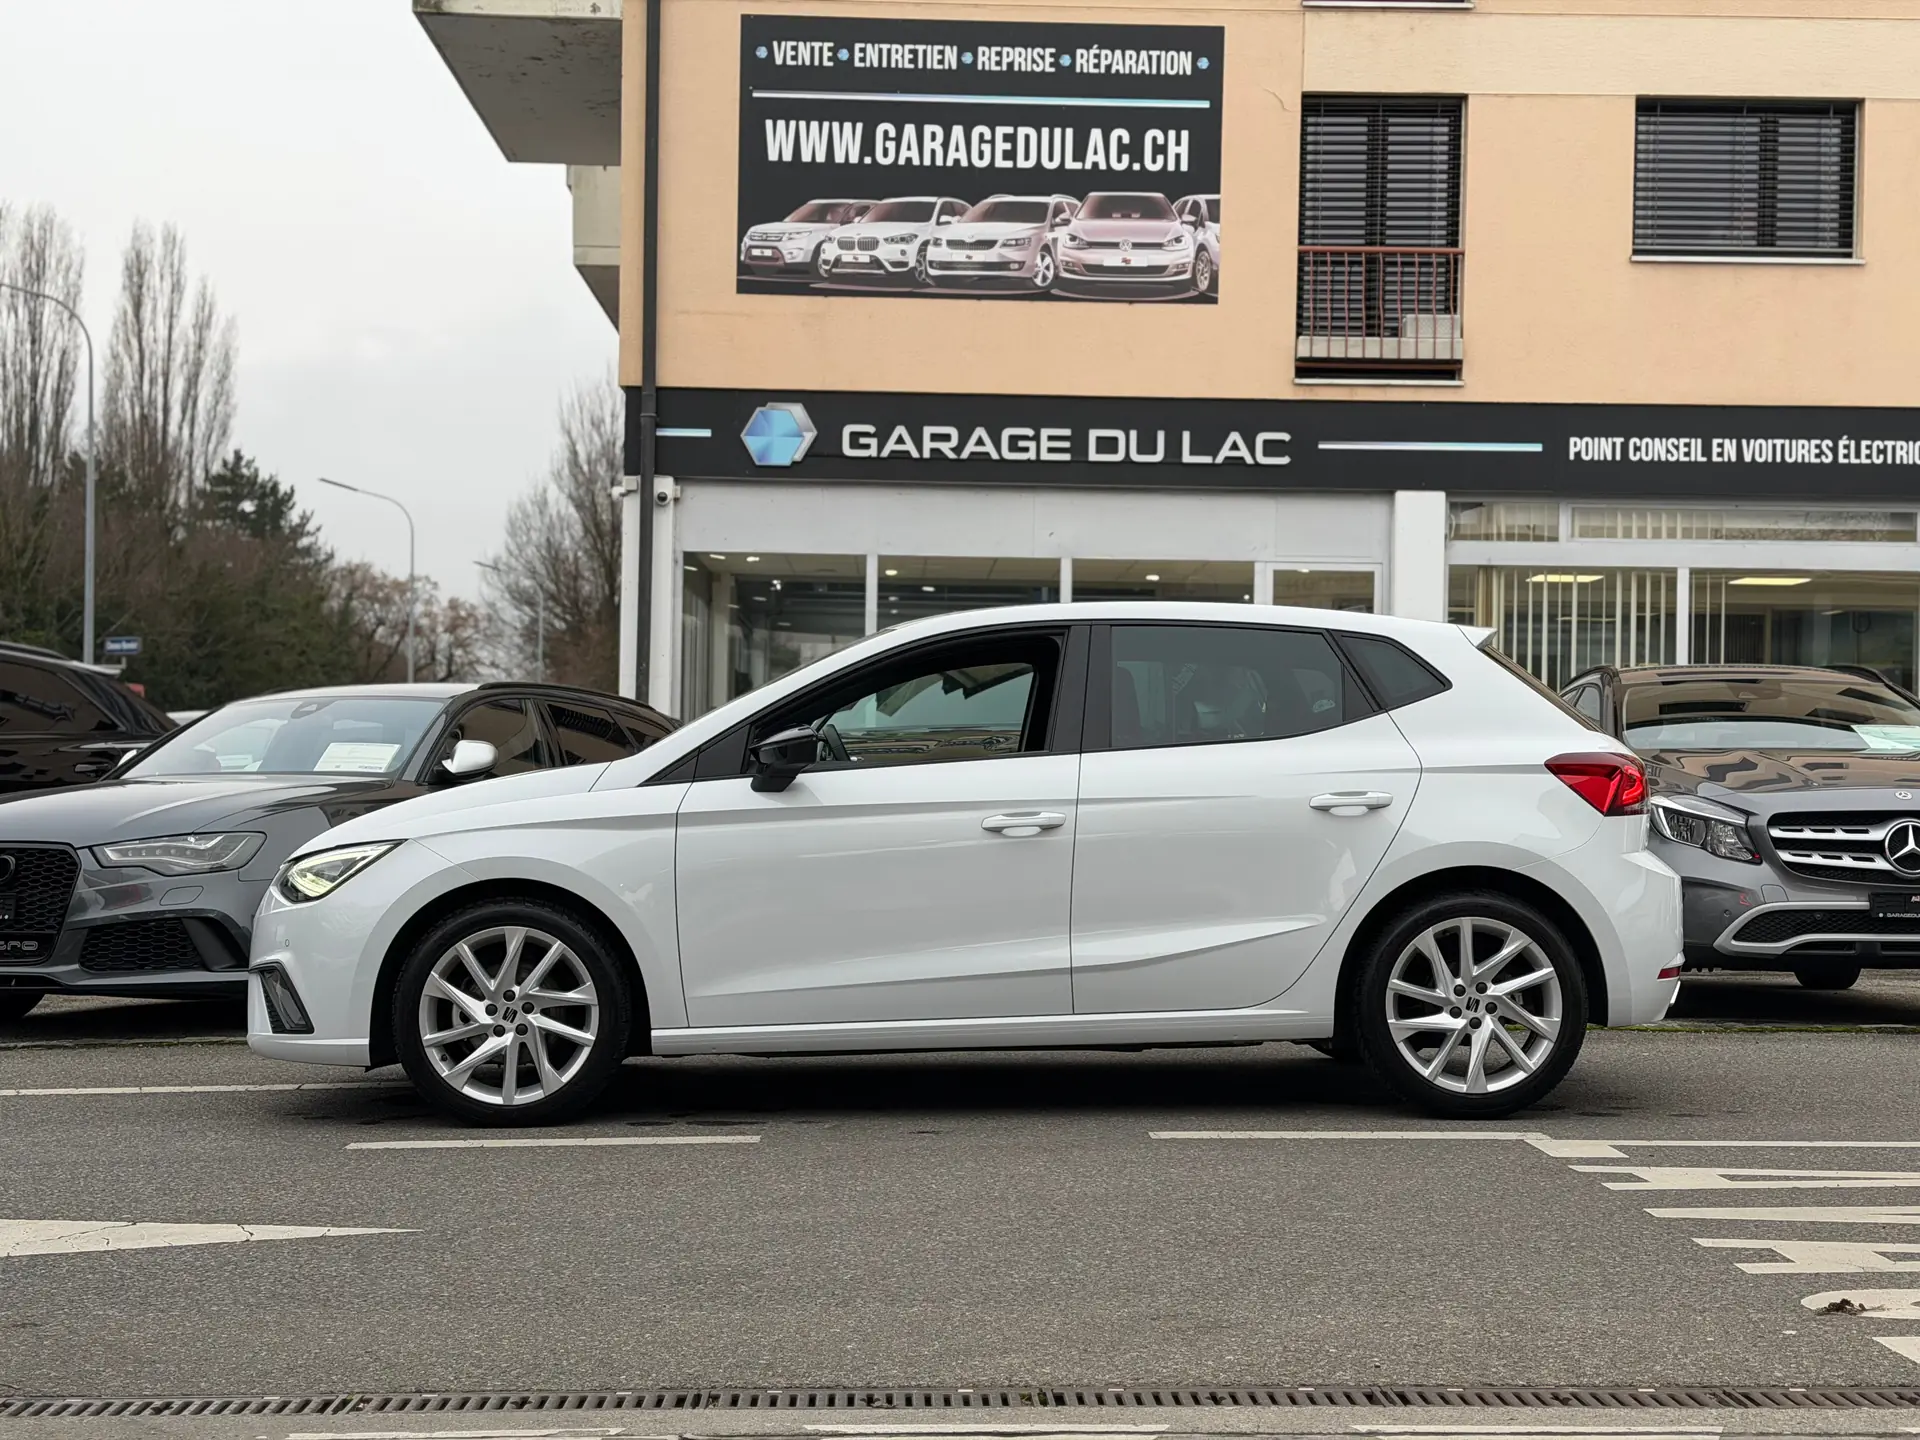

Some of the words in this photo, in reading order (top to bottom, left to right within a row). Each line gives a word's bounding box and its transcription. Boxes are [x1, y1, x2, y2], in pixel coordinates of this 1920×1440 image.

[773, 41, 834, 66] VENTE
[854, 43, 957, 69] ENTRETIEN
[978, 46, 1056, 72] REPRISE
[1076, 44, 1192, 75] RÉPARATION
[766, 119, 1188, 171] WWW.GARAGEDULAC.CH
[843, 425, 1071, 460] GARAGE
[1089, 429, 1164, 462] DU
[1182, 431, 1291, 464] LAC
[1569, 437, 1624, 461] POINT
[1629, 437, 1707, 462] CONSEIL
[1712, 438, 1737, 463] EN
[1742, 439, 1833, 464] VOITURES
